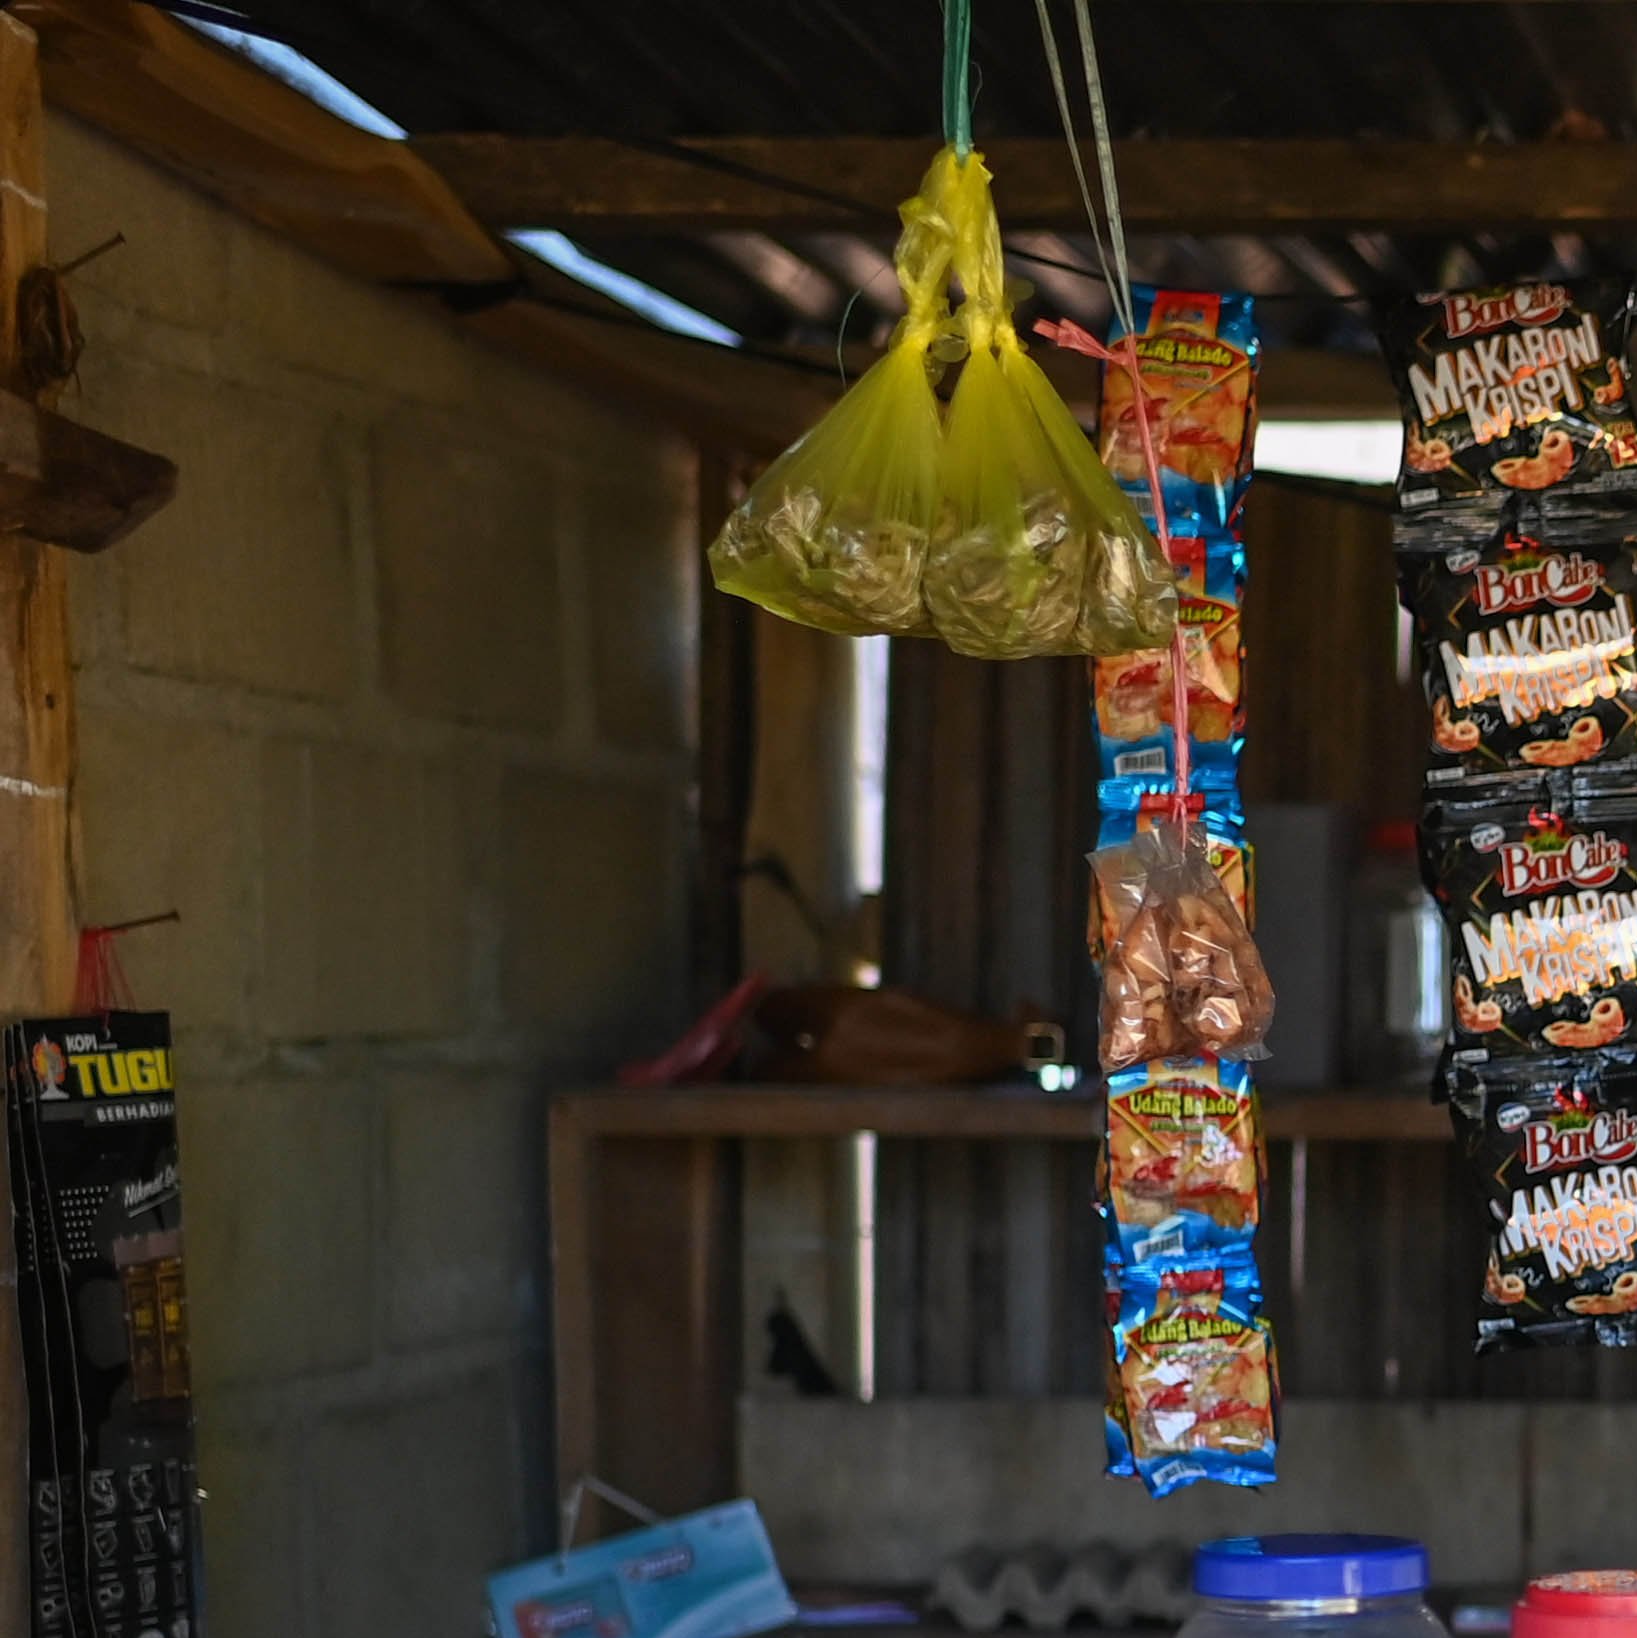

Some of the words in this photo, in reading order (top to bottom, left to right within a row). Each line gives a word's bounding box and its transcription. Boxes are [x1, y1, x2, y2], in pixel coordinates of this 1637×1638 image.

[1176, 342, 1232, 368] Balado
[1409, 313, 1602, 426] MAKARONI
[1464, 362, 1583, 444] KRISPI
[1439, 594, 1635, 708] MAKARONI
[1499, 654, 1608, 728] KRISPI
[1500, 829, 1628, 896] BonCabe
[66, 1033, 97, 1053] KOPI
[69, 1048, 175, 1098] TUGU
[1128, 1094, 1181, 1119] Udang
[1182, 1095, 1238, 1117] Balado
